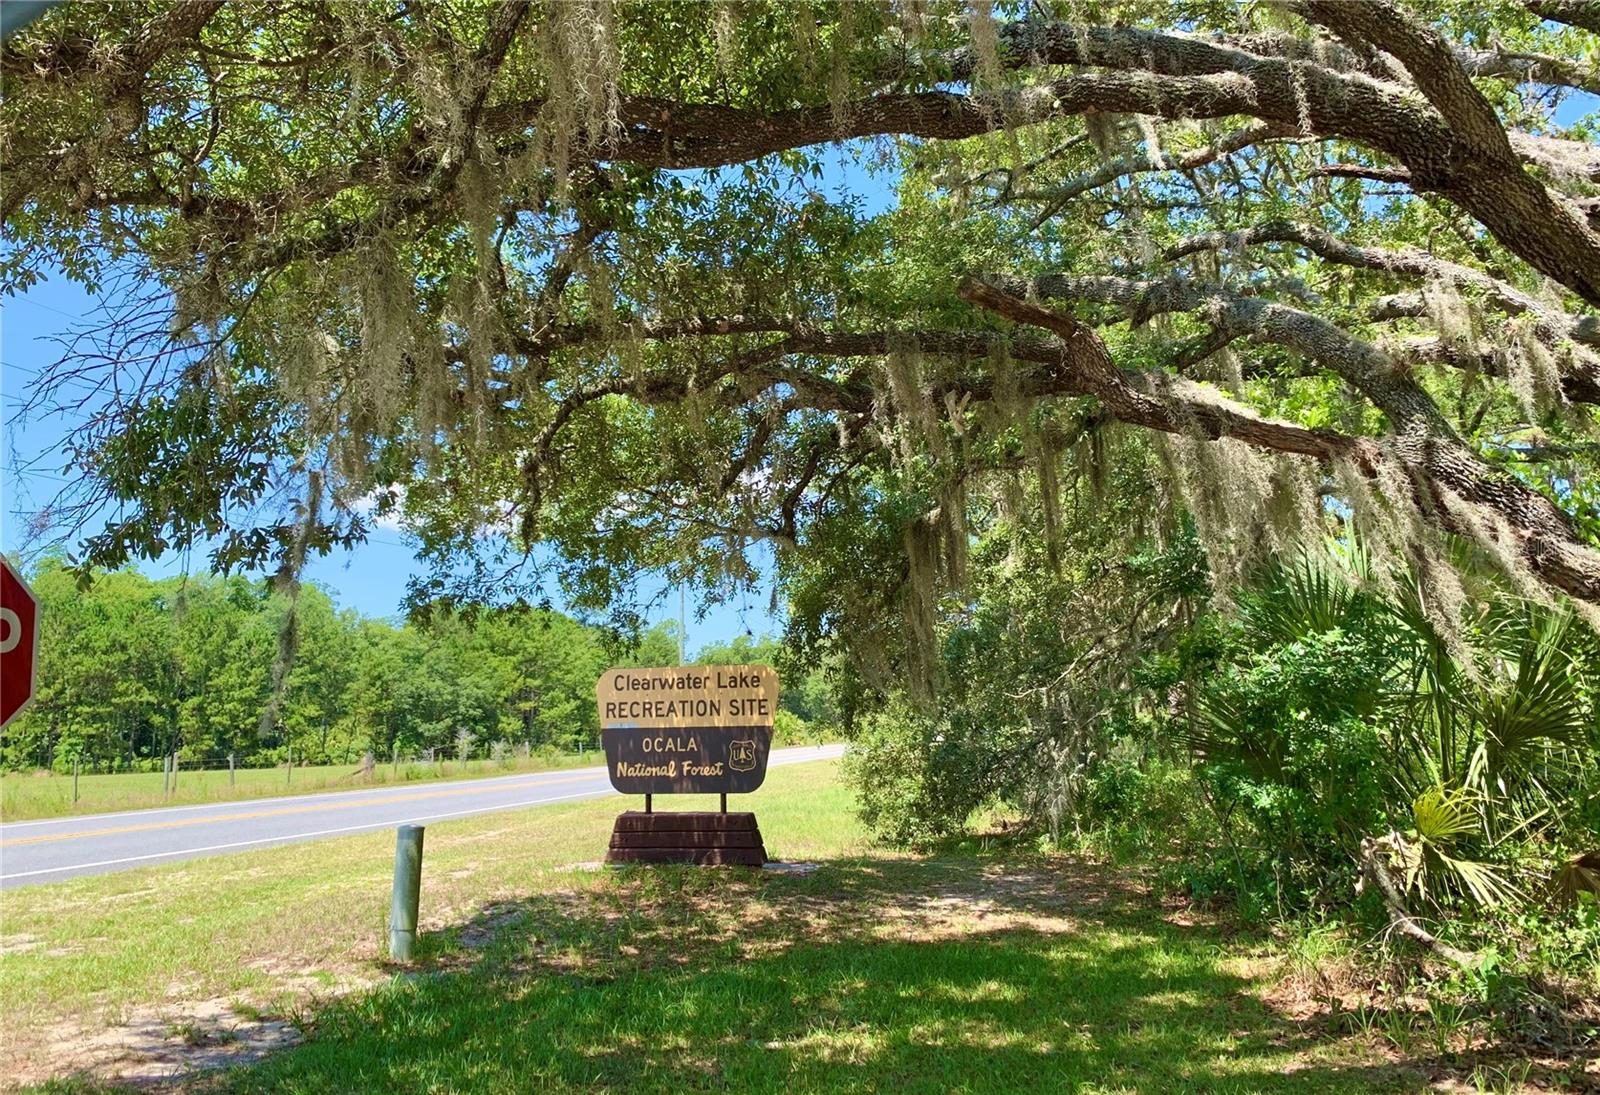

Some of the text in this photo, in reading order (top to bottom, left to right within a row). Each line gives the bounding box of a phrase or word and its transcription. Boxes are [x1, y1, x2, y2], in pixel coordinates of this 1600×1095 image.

[614, 671, 761, 691] Clearwater Lake
[606, 698, 769, 719] RECREATION SITE
[642, 737, 698, 753] OCALA
[616, 760, 677, 778] National
[681, 760, 724, 776] Forest
